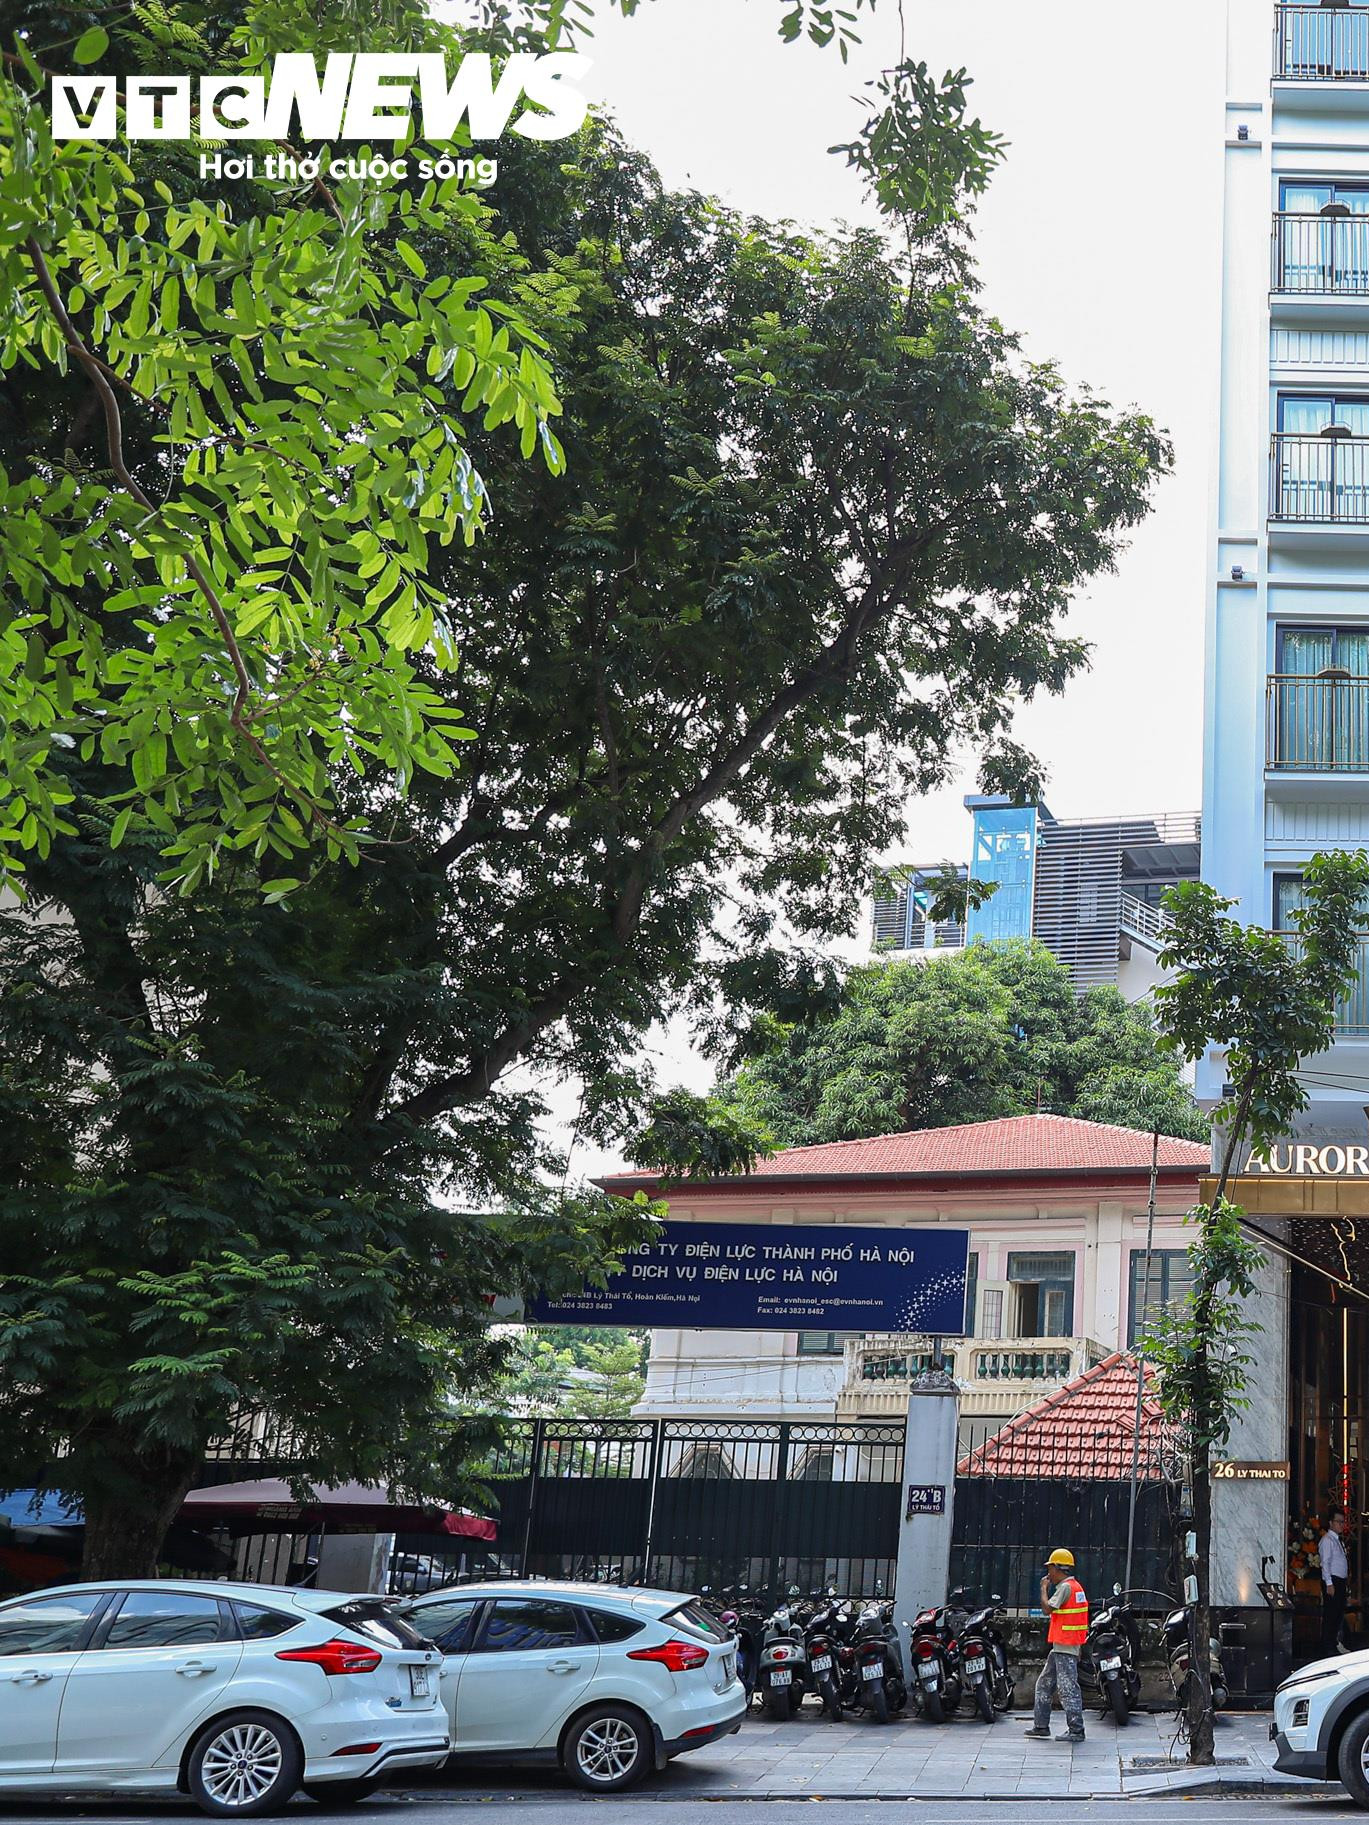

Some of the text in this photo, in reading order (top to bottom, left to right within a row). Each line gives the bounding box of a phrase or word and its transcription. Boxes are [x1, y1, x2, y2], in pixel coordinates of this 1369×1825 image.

[658, 1243, 678, 1256] TY
[685, 1241, 720, 1260] ĐIỆN
[726, 1243, 756, 1261] LỰC
[762, 1243, 815, 1260] THÀNH
[821, 1242, 854, 1261] PHỐ
[859, 1245, 881, 1262] HÀ
[888, 1247, 915, 1266] NỘI
[632, 1264, 668, 1281] DỊCH
[675, 1266, 697, 1282] VỤ
[704, 1264, 739, 1283] ĐIỆN
[745, 1267, 776, 1284] LỰC
[782, 1266, 804, 1282] HÀ
[811, 1267, 838, 1286] NỘI
[758, 1296, 780, 1304] Email:
[1214, 1462, 1286, 1478] 26 LY THAI TO
